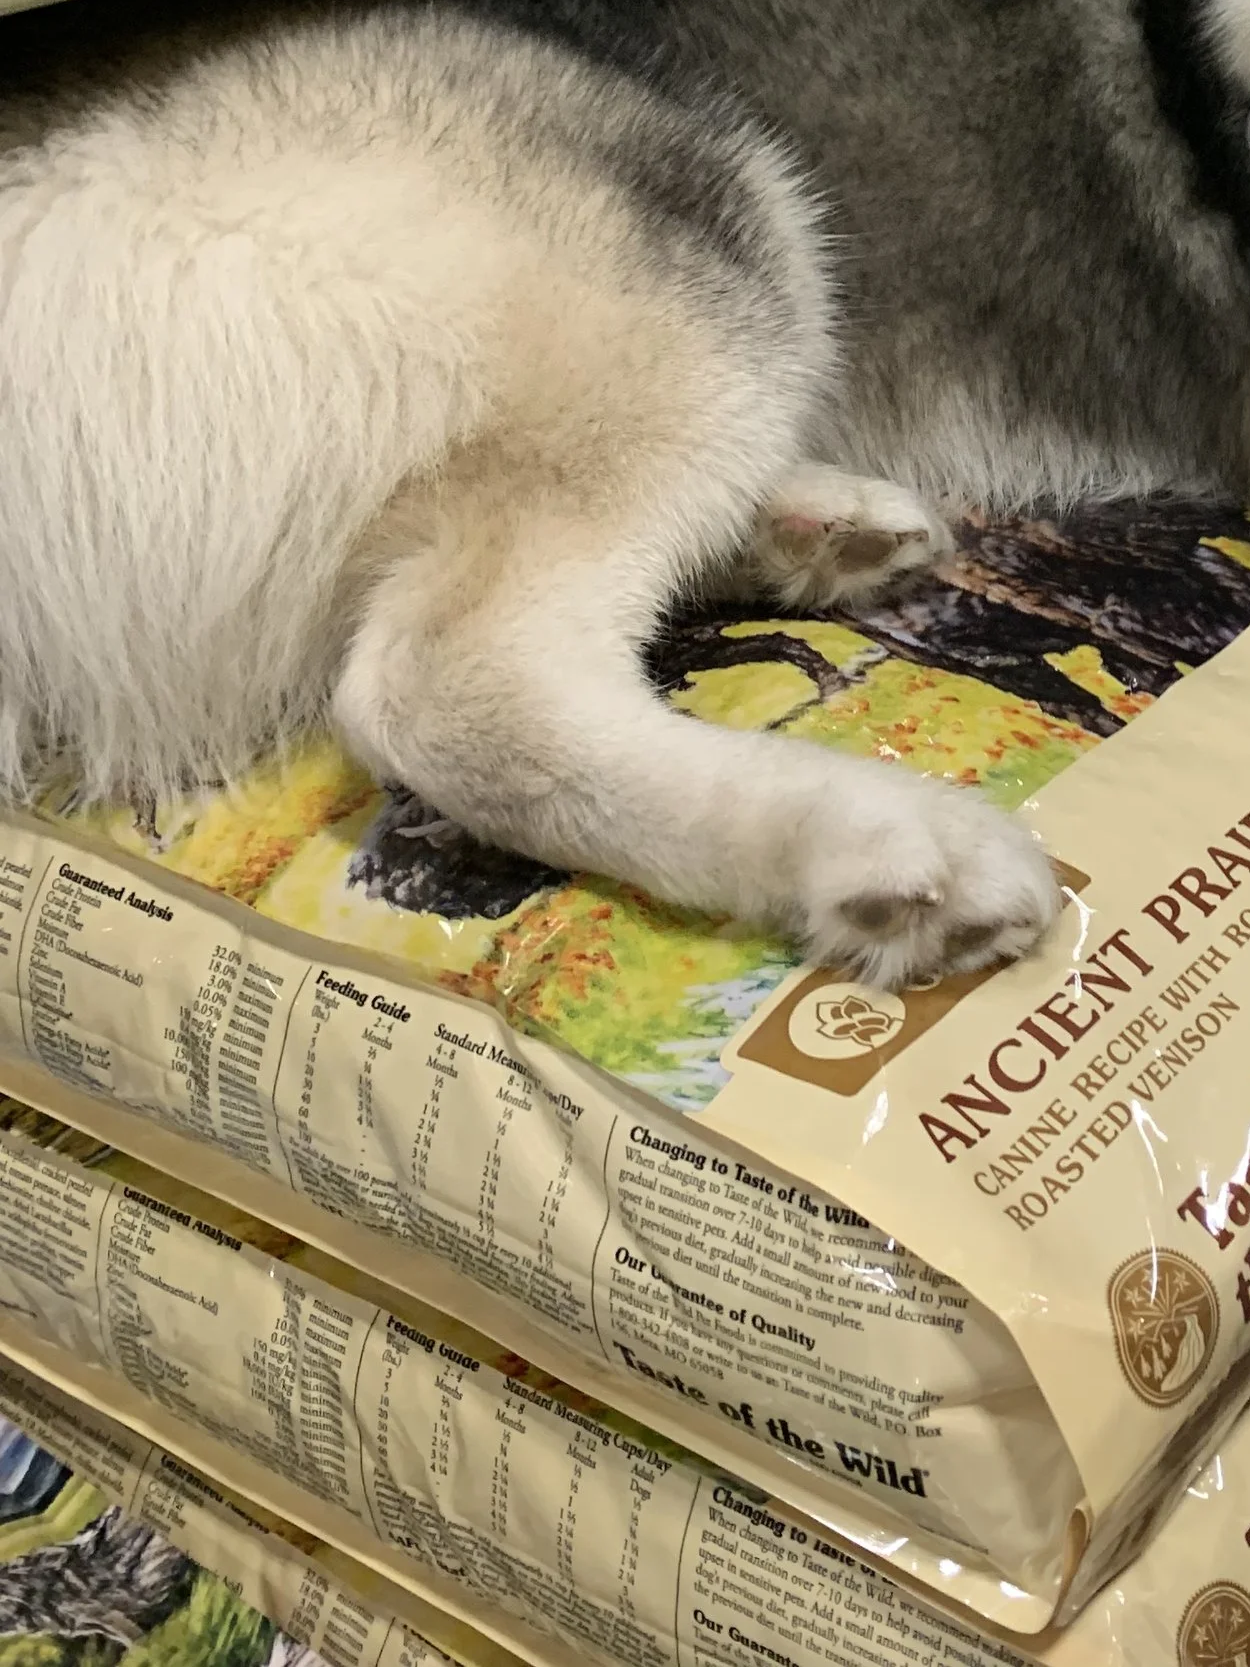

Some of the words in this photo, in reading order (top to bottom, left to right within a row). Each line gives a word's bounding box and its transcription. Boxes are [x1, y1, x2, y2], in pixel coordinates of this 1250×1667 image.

[58, 863, 126, 902] Guaranteed
[124, 891, 174, 922] Analysis
[315, 970, 367, 1008] Feeding
[371, 994, 412, 1023] Guide
[434, 1023, 488, 1055] Standard
[917, 928, 1156, 1165] ANCIENT
[974, 1099, 1079, 1198] CANINE
[1072, 1003, 1169, 1109] RECIPE
[1161, 943, 1233, 1014] WITH
[495, 1087, 532, 1112] Months
[1003, 1099, 1134, 1232] ROASTED
[1129, 993, 1242, 1105] VENISON
[625, 1145, 655, 1170] When
[658, 1161, 706, 1193] changing
[709, 1181, 720, 1195] to
[724, 1183, 750, 1206] Taste
[752, 1198, 764, 1211] of
[630, 1126, 706, 1171] Changing
[711, 1157, 728, 1175] to
[734, 1163, 774, 1195] Taste
[778, 1187, 796, 1204] of
[797, 1192, 819, 1217] the
[613, 1246, 647, 1274] Our
[729, 1307, 748, 1325] of
[751, 1314, 817, 1352] Quality
[502, 1375, 553, 1418] Standard
[553, 1400, 612, 1447] Measuring
[612, 1432, 672, 1476] Cups/Day
[613, 1340, 709, 1407] Taste
[717, 1400, 757, 1430] of
[765, 1417, 826, 1460] the
[834, 1439, 927, 1497] Wild
[708, 1506, 736, 1532] When
[739, 1527, 785, 1561] changing
[802, 1552, 828, 1577] Taste
[693, 1609, 723, 1634] Our
